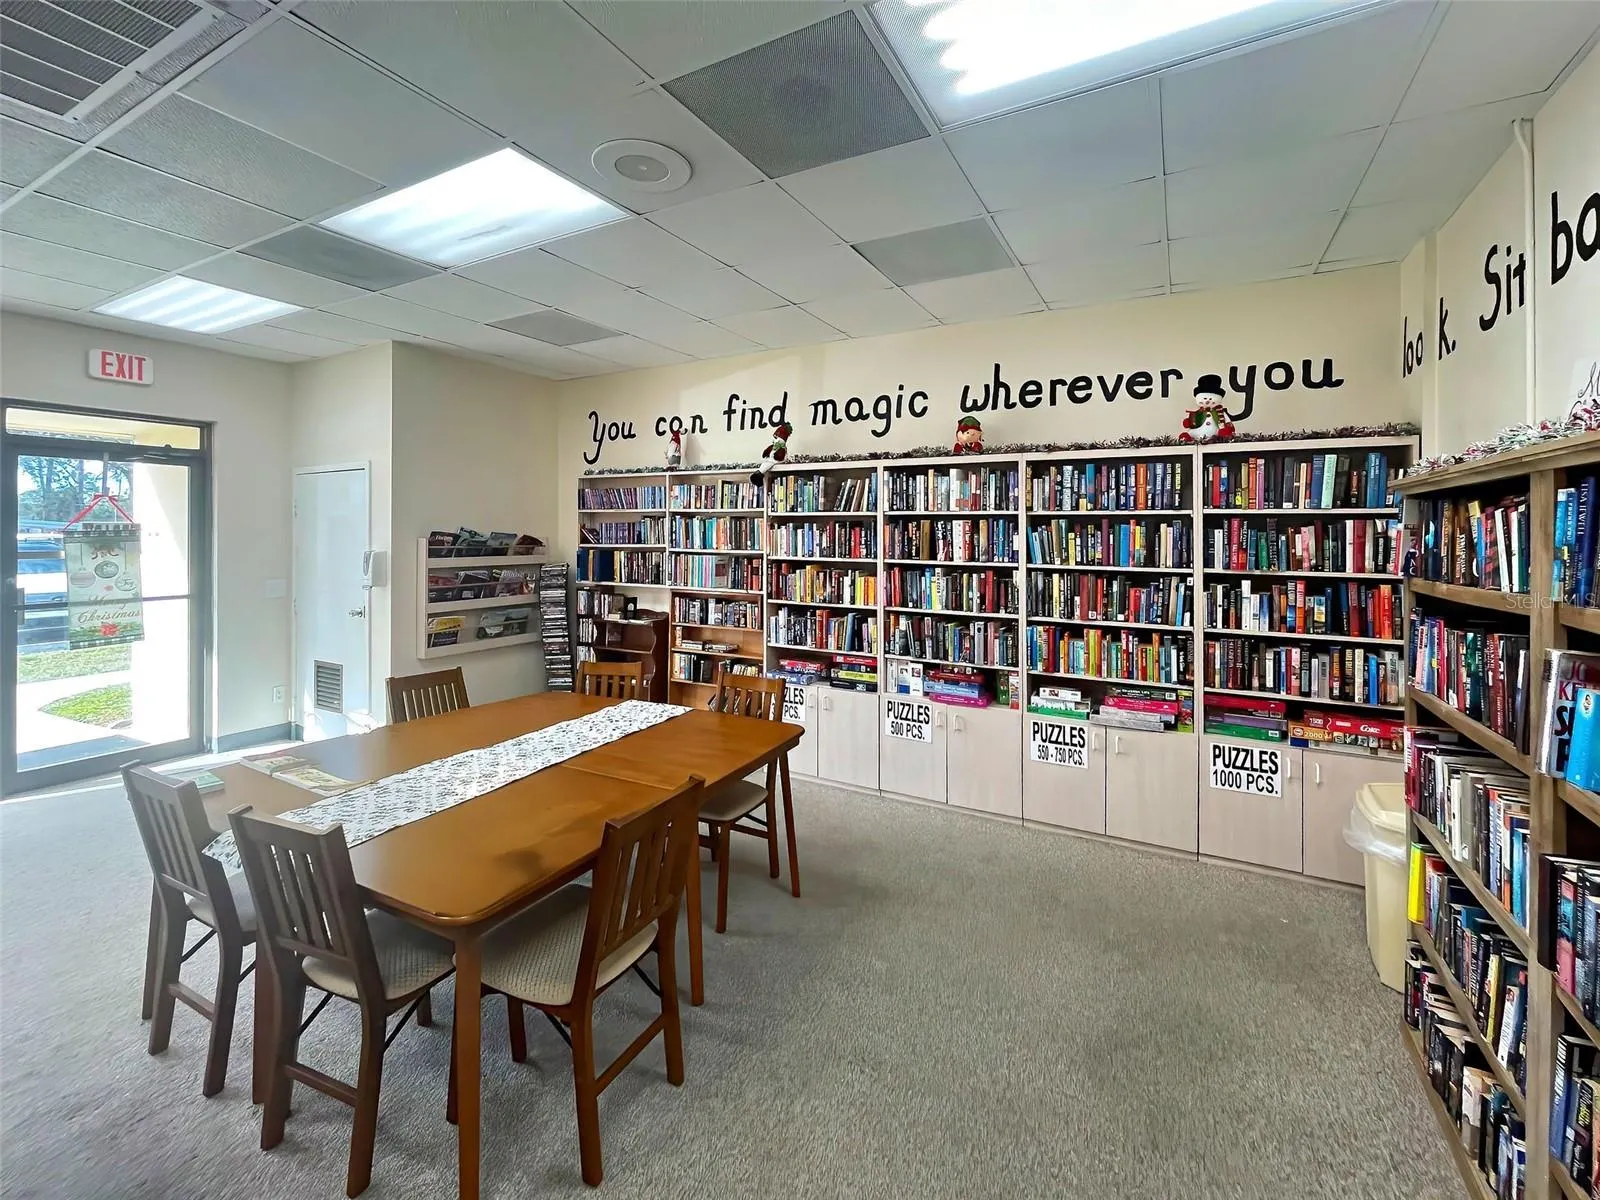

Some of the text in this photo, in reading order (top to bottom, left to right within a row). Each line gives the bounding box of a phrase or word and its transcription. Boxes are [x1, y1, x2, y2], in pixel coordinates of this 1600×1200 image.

[1479, 191, 1600, 332] Sit ba
[101, 351, 146, 382] EXIT
[583, 358, 1344, 465] You can find magic wherever you
[1577, 483, 1589, 536] LISA JEWELL
[784, 687, 804, 705] ZLES
[784, 705, 801, 719] PCS.
[887, 700, 930, 725] PUZZLES
[891, 723, 925, 740] 500 PCS.
[1032, 721, 1086, 748] PUZZLES
[1037, 744, 1050, 760] 550
[1054, 747, 1067, 763] 750
[1068, 749, 1085, 766] PCS.
[1212, 744, 1279, 775] PUZZLES
[1212, 769, 1278, 795] 1000 PCS.
